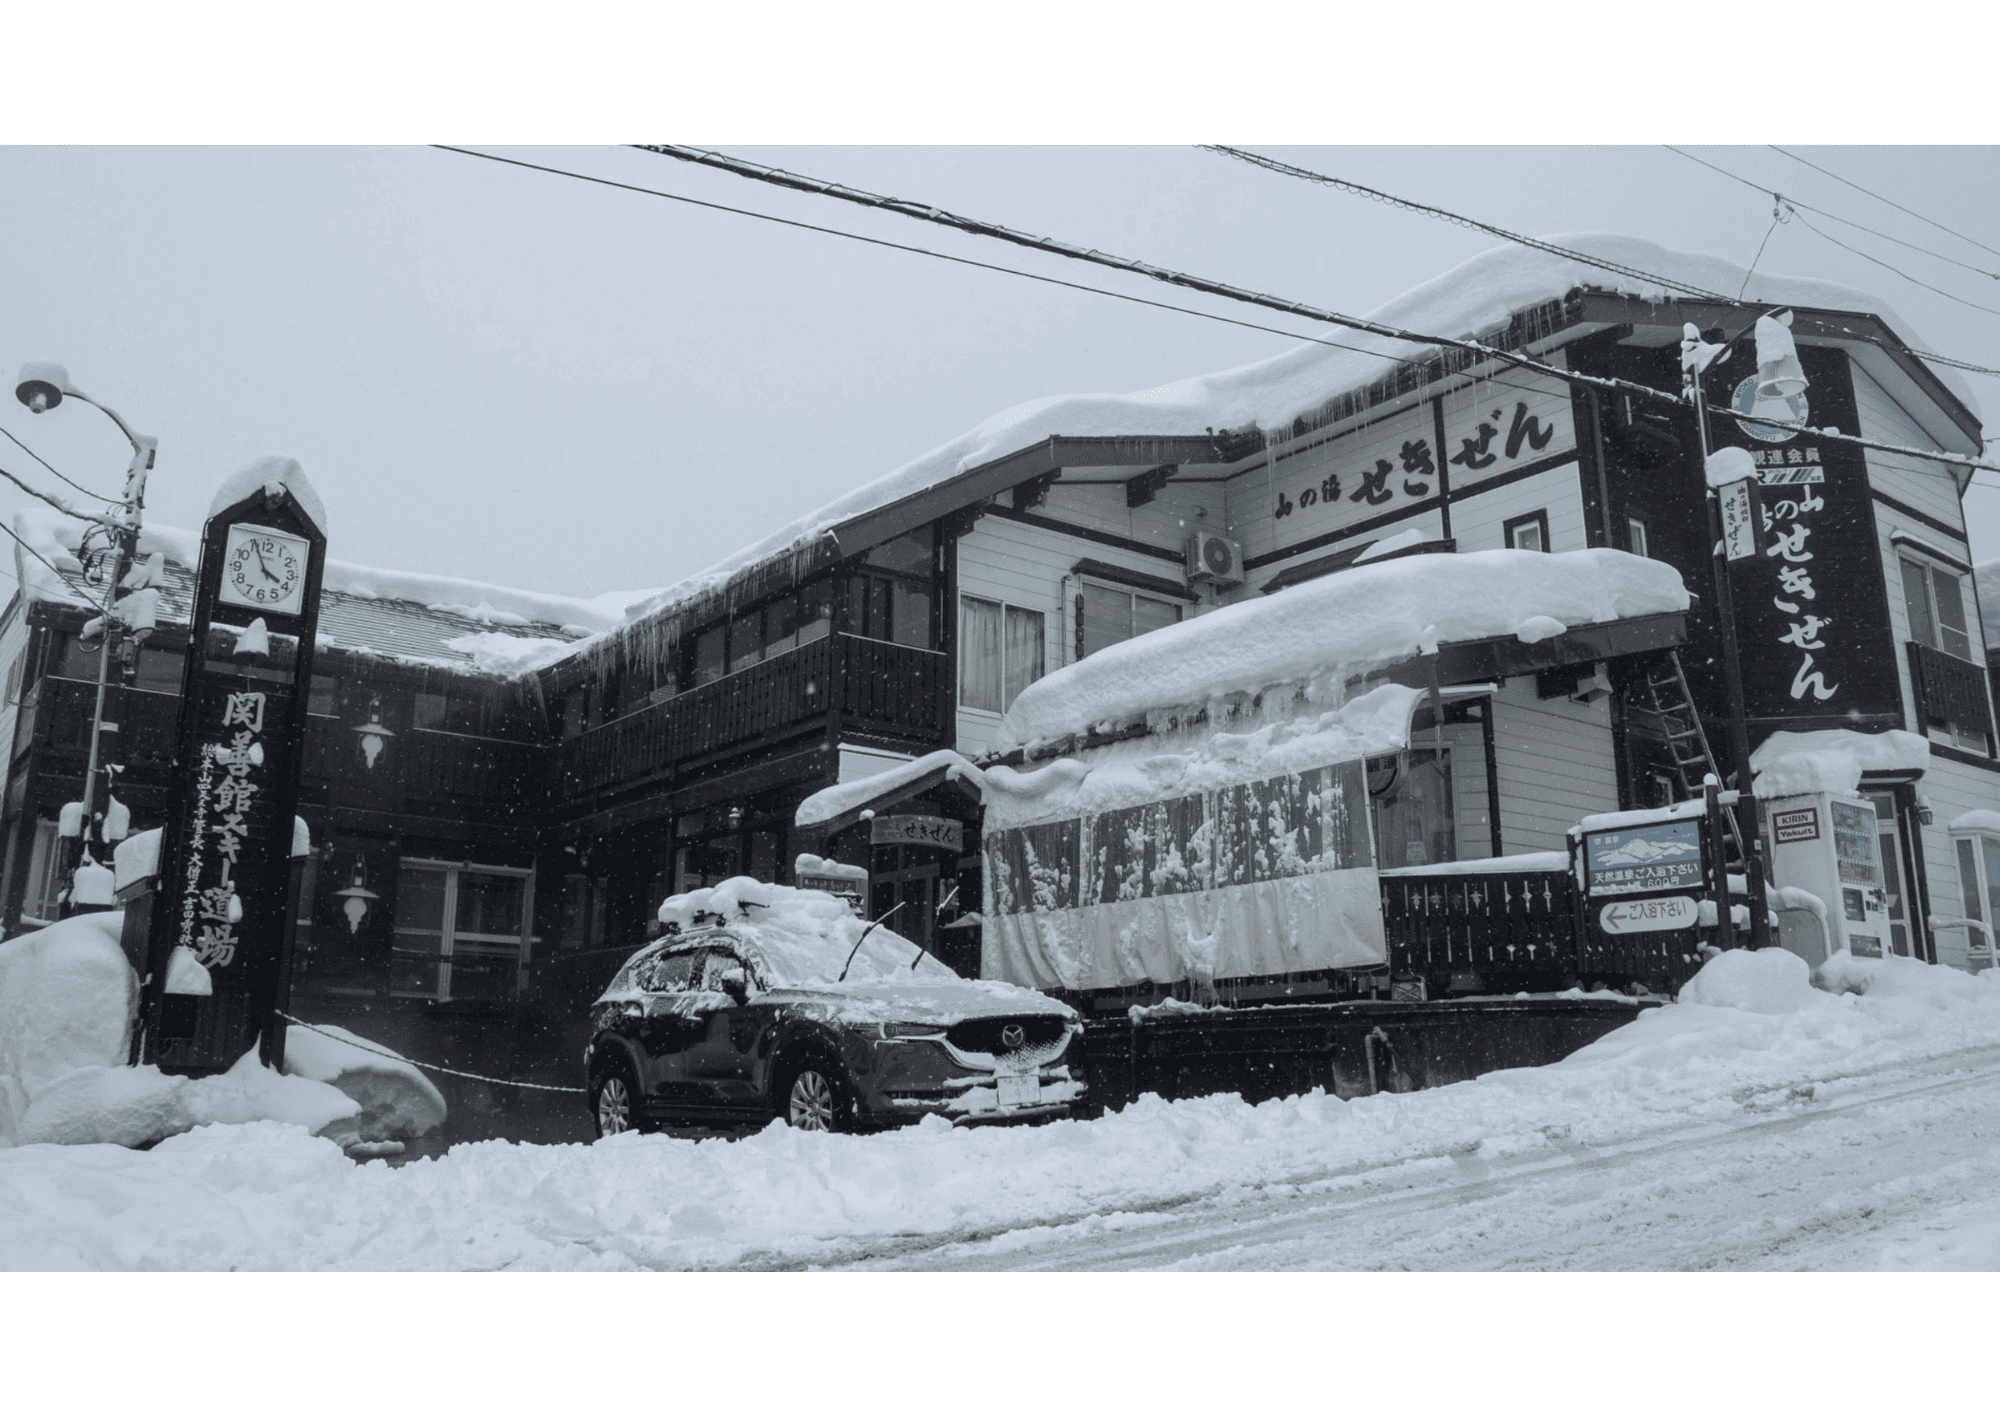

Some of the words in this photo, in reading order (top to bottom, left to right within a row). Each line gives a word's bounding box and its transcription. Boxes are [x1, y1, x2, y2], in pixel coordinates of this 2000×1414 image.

[1349, 402, 1554, 506] せきぜん
[1724, 497, 1742, 557] せきぜん
[262, 541, 274, 553] 12
[237, 549, 250, 561] 10
[233, 561, 242, 572] 9
[284, 557, 293, 568] 2
[236, 572, 245, 584] 8
[286, 570, 294, 581] 3
[245, 584, 254, 594] 7
[281, 581, 289, 592] 4
[256, 589, 265, 600] 6
[270, 588, 279, 599] 5
[1766, 523, 1840, 700] せきぜん
[1781, 813, 1809, 825] KIRIN
[195, 692, 267, 968] 関善館スキー道場
[905, 822, 955, 843] せきぜん
[1780, 828, 1814, 839] Yakult
[1593, 858, 1699, 884] 天然温泉ご入浴下さい
[1629, 900, 1687, 920] ご入浴下さい
